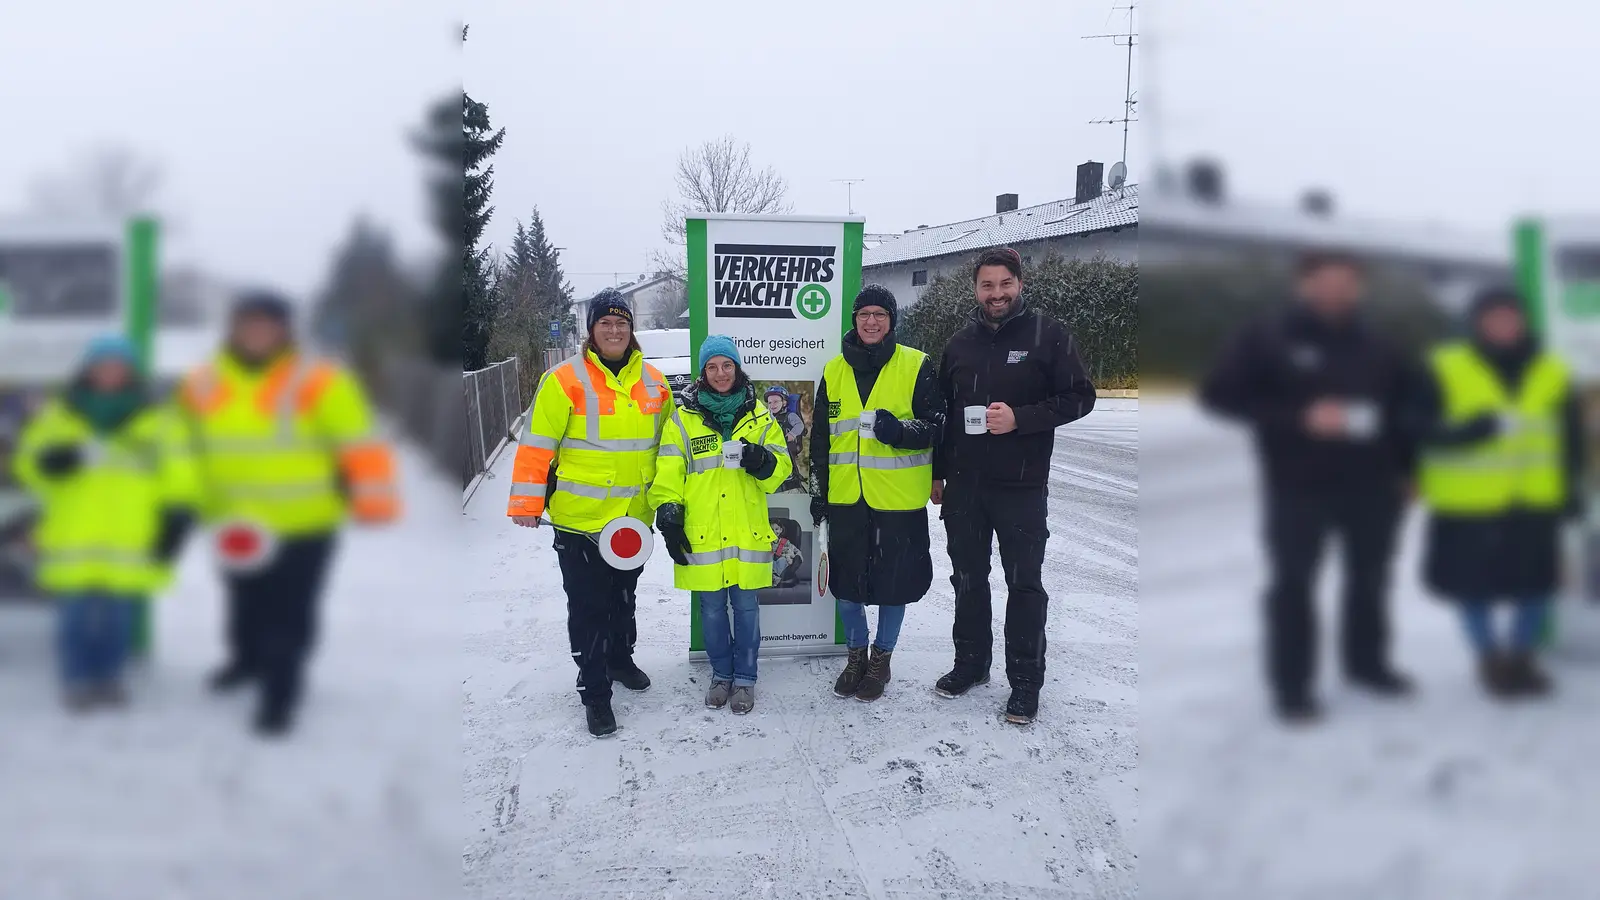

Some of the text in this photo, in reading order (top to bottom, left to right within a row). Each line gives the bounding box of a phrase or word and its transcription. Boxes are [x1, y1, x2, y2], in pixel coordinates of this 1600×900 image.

[714, 255, 836, 282] VERKEHRS
[714, 281, 798, 307] WACHT
[731, 337, 825, 351] inder gesichert
[743, 354, 807, 367] unterwegs
[760, 632, 828, 641] rswacht-bayern.de
